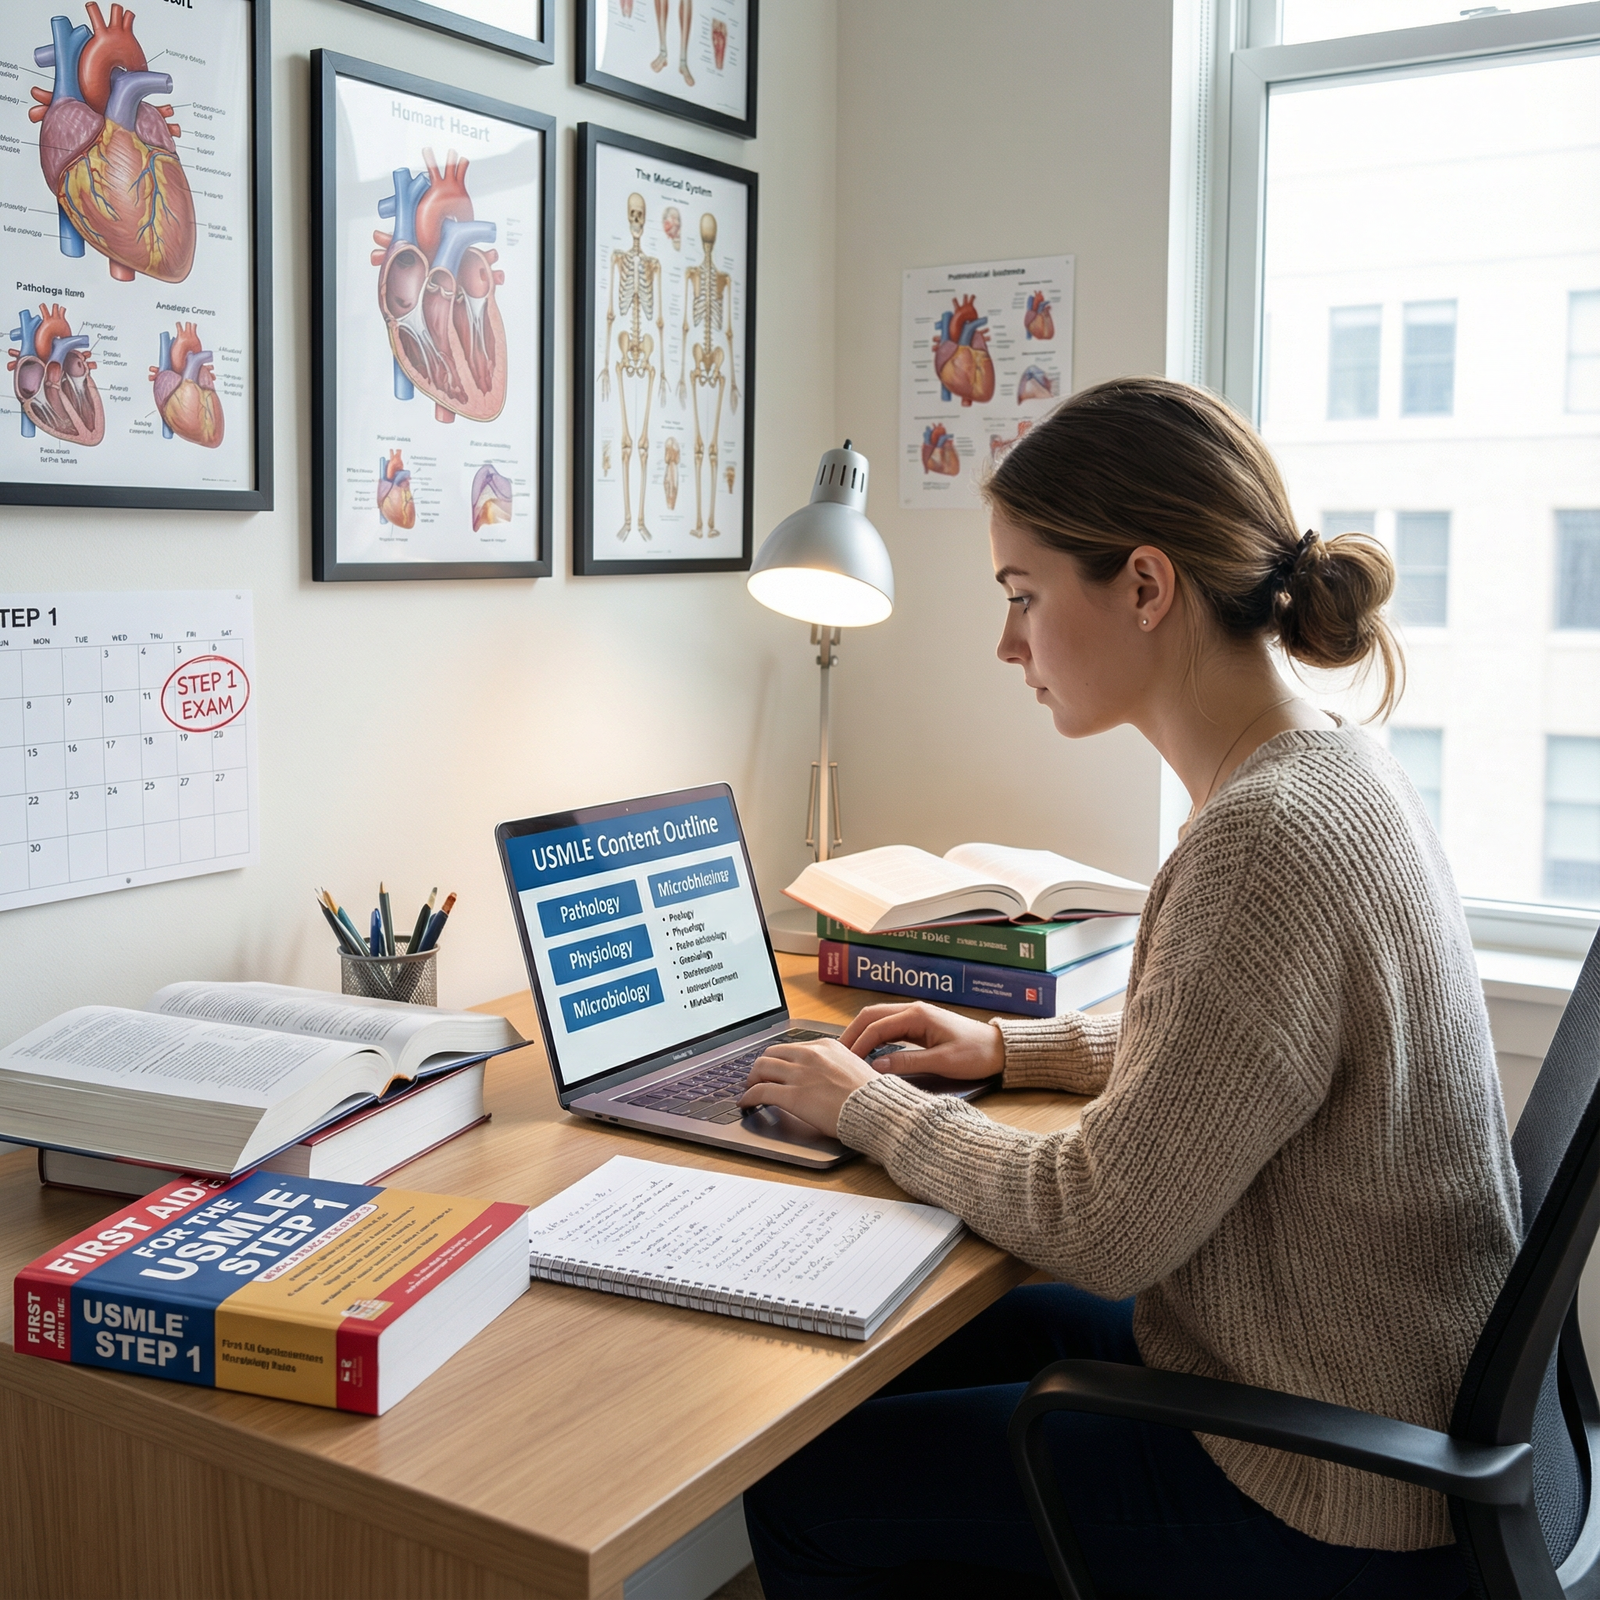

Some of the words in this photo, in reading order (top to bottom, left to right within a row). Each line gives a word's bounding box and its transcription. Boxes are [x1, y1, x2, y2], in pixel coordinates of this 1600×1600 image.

[450, 116, 490, 143] Heart
[0, 608, 40, 628] TEP
[48, 607, 57, 626] 1
[33, 637, 50, 645] MON
[74, 635, 88, 643] TUE
[111, 634, 128, 642] WED
[150, 632, 163, 640] THU
[221, 629, 232, 637] SAT
[104, 649, 109, 658] 3
[140, 647, 146, 655] 4
[177, 645, 182, 654] 5
[211, 643, 217, 651] 6
[177, 671, 222, 696] STEP
[226, 669, 238, 689] 1
[26, 701, 32, 710] 8
[66, 697, 72, 706] 9
[104, 694, 114, 704] 10
[143, 692, 151, 700] 11
[182, 695, 234, 720] EXAM
[27, 748, 38, 757] 15
[67, 744, 78, 753] 16
[106, 740, 116, 749] 17
[143, 736, 154, 746] 18
[179, 733, 189, 742] 19
[28, 796, 39, 806] 22
[68, 791, 80, 800] 23
[107, 786, 118, 796] 24
[144, 781, 155, 791] 25
[180, 777, 190, 787] 27
[215, 773, 225, 782] 27
[531, 838, 594, 872] USMLE
[597, 825, 661, 858] Content
[663, 815, 719, 845] Outline
[560, 894, 621, 924] Pathology
[569, 938, 634, 970] Physiology
[856, 956, 953, 993] Pathoma
[573, 982, 651, 1020] Microbiology
[44, 1216, 153, 1276] FIRST
[145, 1184, 207, 1221] AID
[132, 1226, 195, 1259] FOR
[182, 1197, 243, 1226] THE
[139, 1188, 311, 1281] USMLE
[218, 1214, 317, 1276] STEP
[312, 1198, 350, 1210] 1
[27, 1291, 41, 1344] FIRST
[42, 1310, 56, 1343] AID
[95, 1330, 178, 1367] STEP
[186, 1345, 201, 1373] 1
